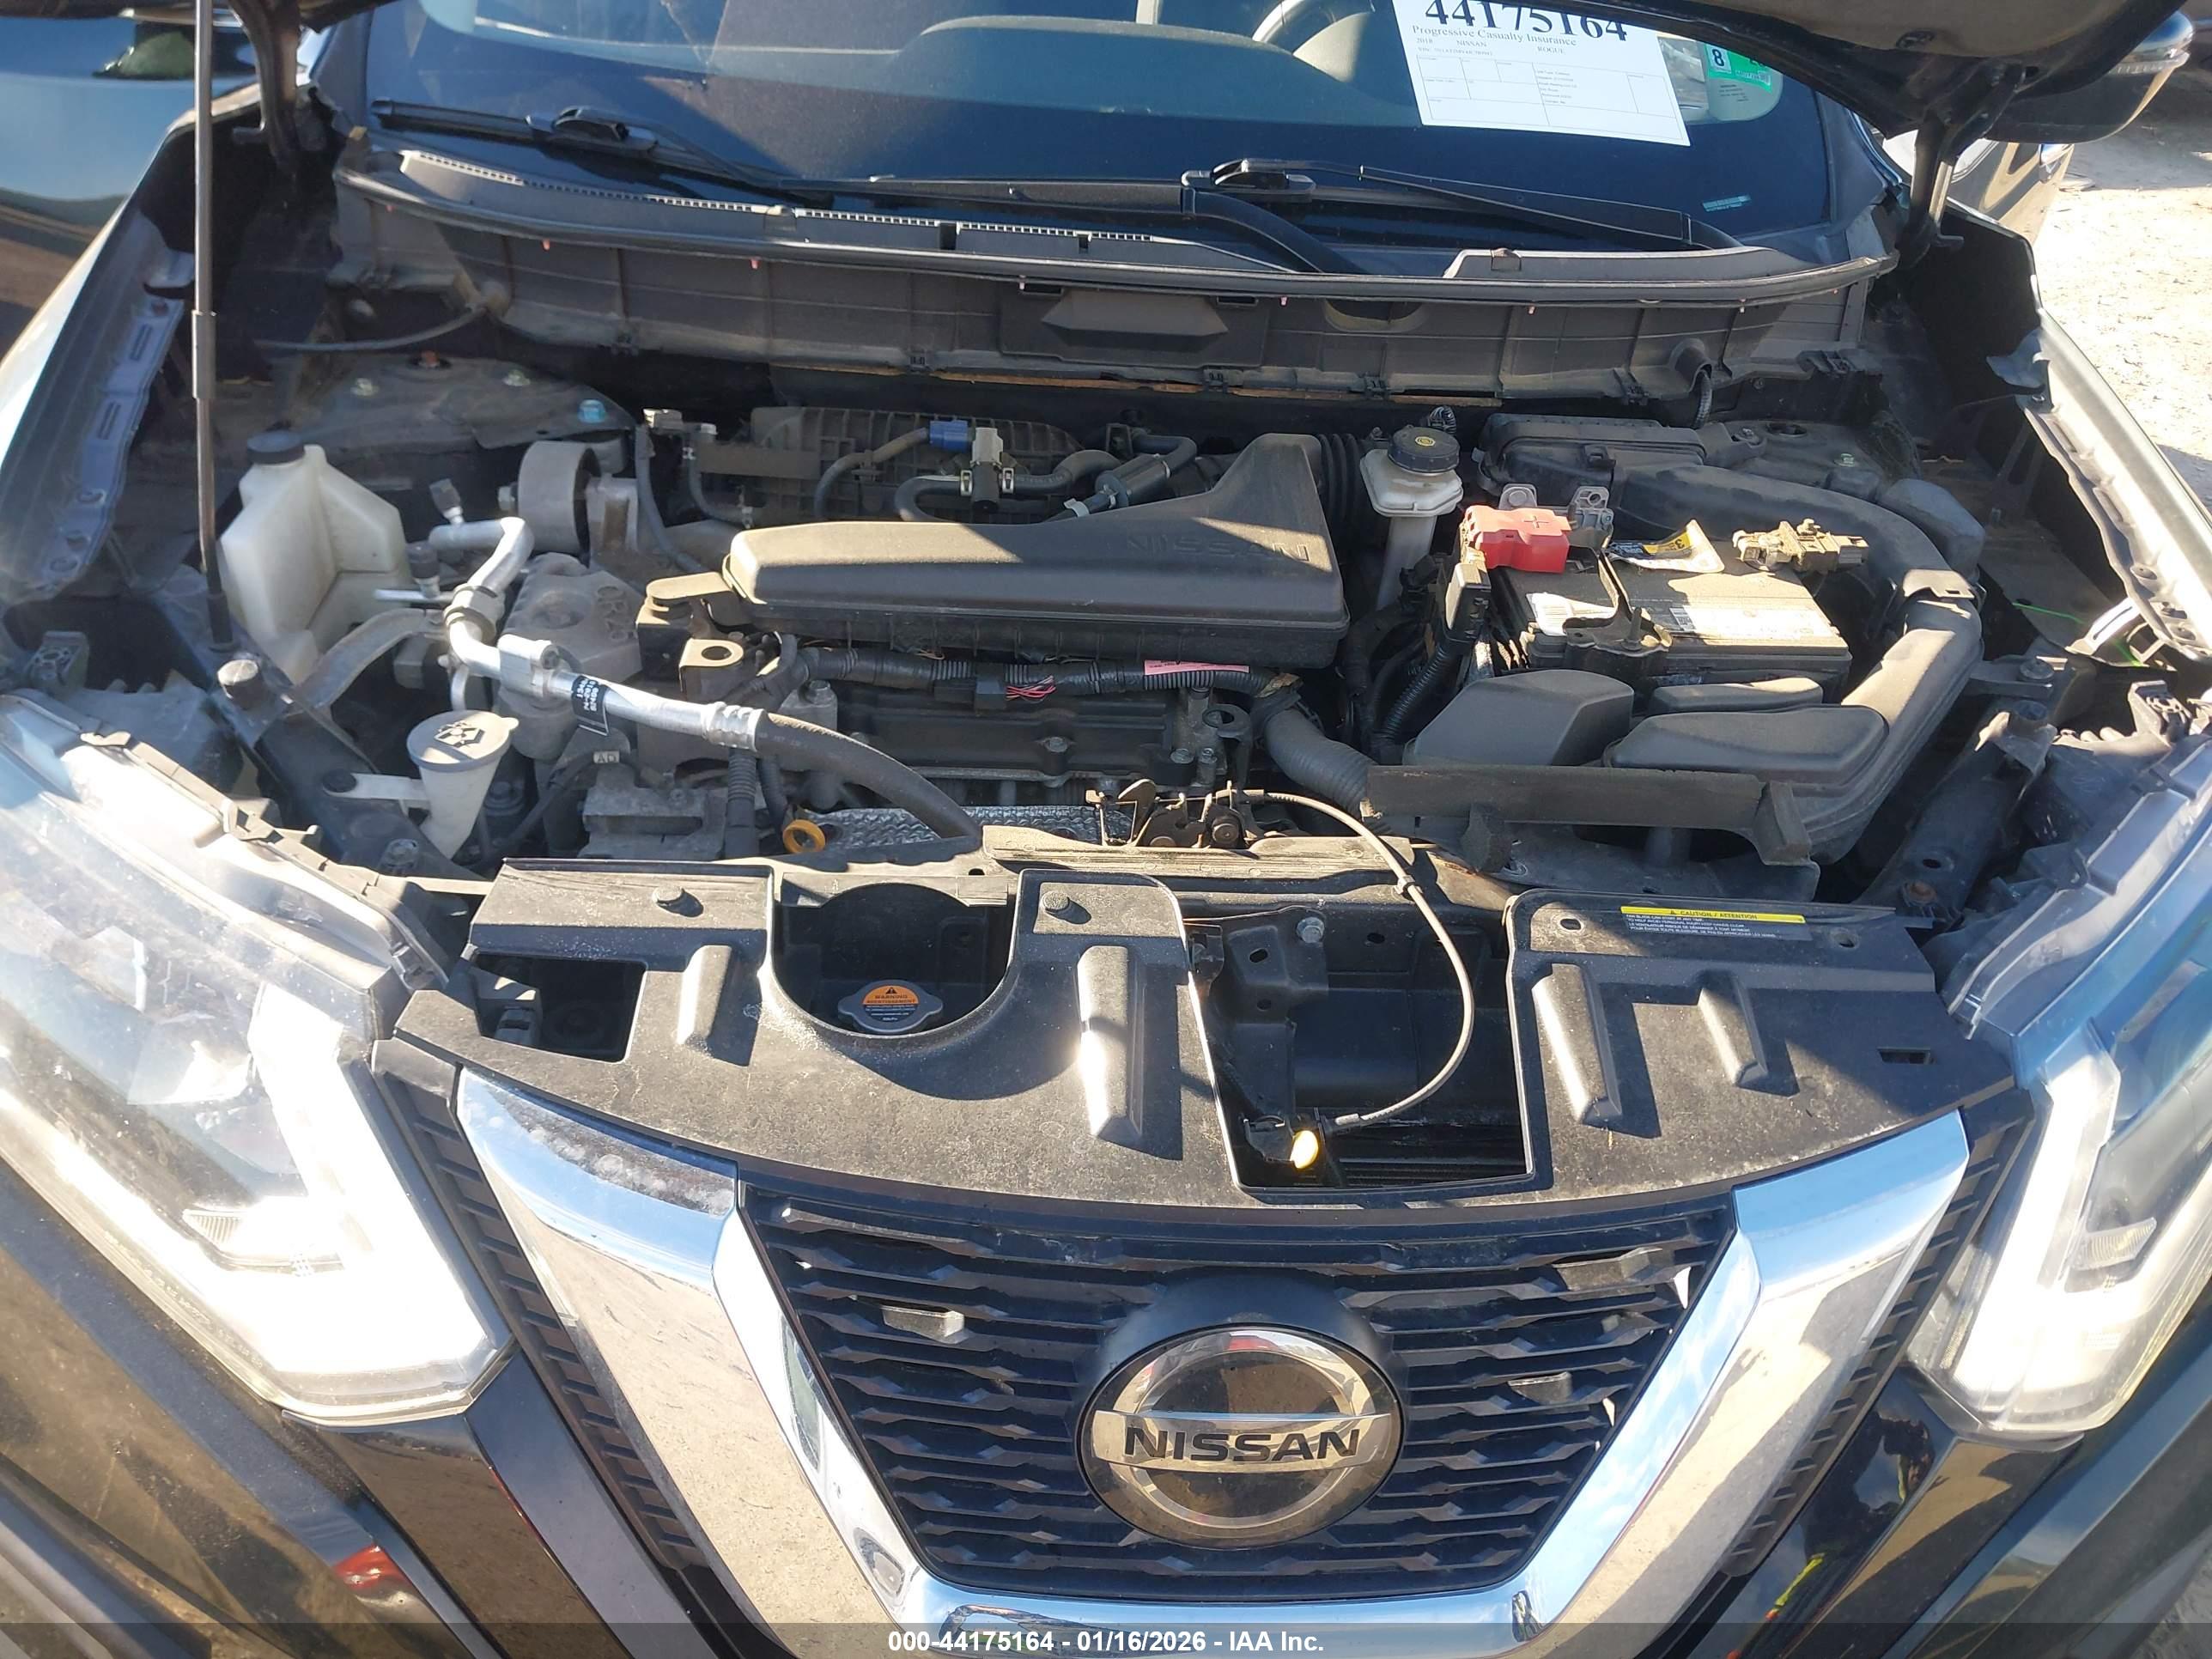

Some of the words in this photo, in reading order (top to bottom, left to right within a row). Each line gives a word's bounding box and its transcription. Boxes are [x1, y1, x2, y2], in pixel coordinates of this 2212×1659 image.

[1425, 0, 1627, 41] 44175164
[1413, 25, 1474, 38] Progressive
[1478, 28, 1523, 43] Casualty
[1527, 33, 1577, 46] Insurance
[1711, 48, 1725, 67] 8
[1127, 533, 1310, 562] NISSAN
[1124, 1426, 1359, 1462] NISSAN
